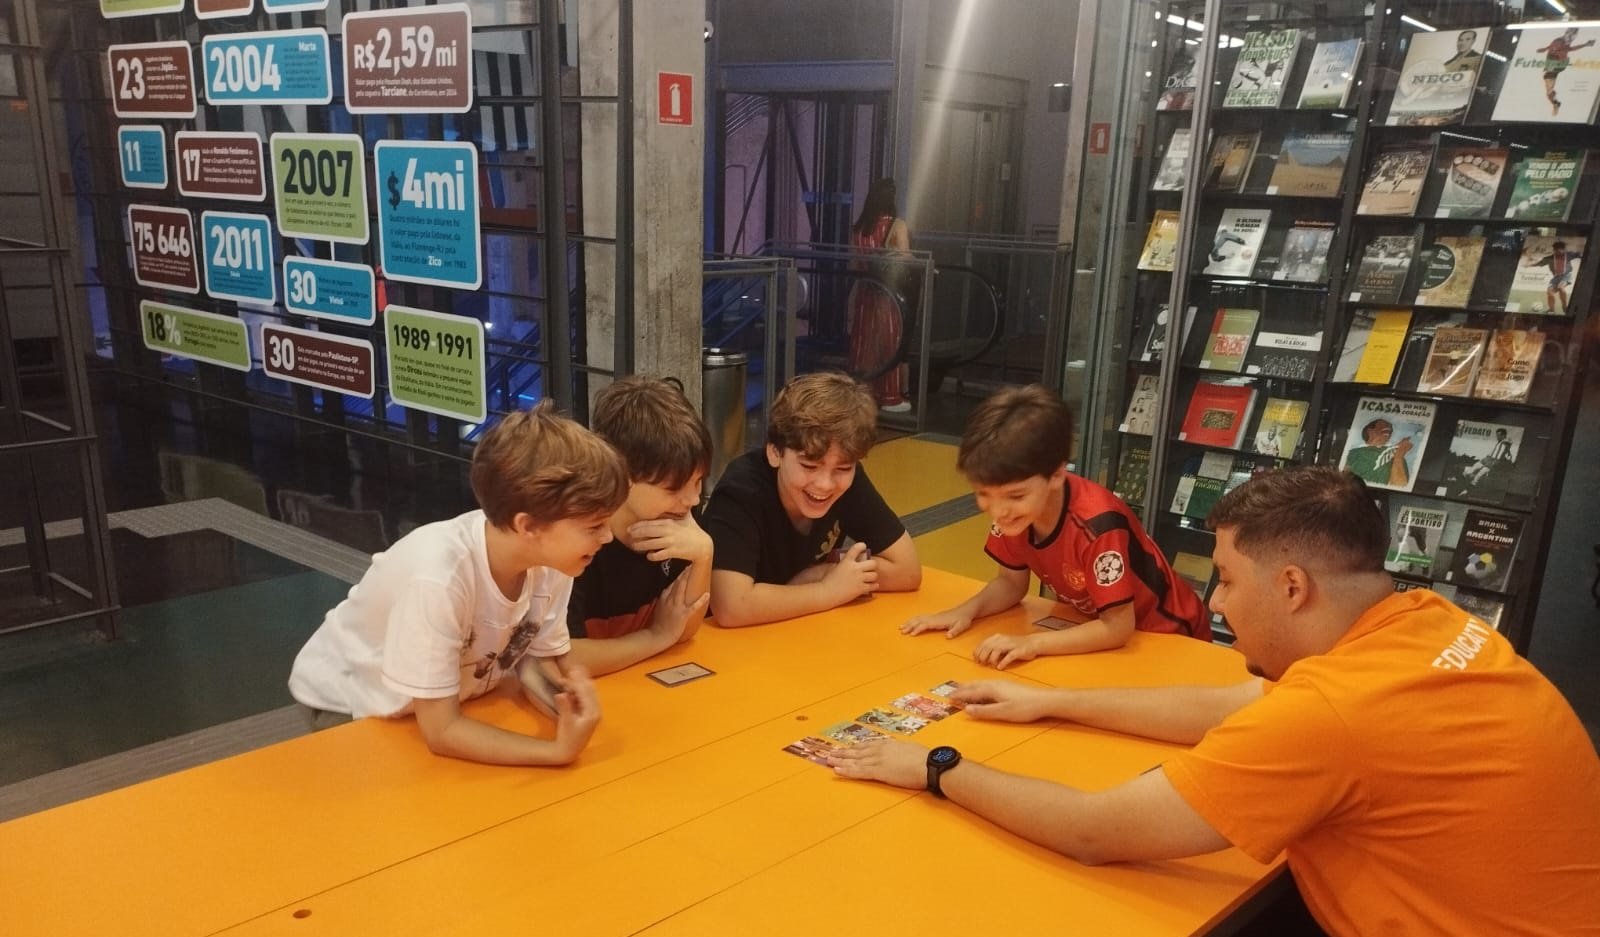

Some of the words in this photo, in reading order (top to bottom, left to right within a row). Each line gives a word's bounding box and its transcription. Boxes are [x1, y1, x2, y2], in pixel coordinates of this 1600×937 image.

[117, 57, 146, 99] 23
[210, 44, 281, 93] 2004
[1412, 72, 1464, 85] NECO
[125, 141, 142, 172] 11
[183, 149, 200, 182] 17
[281, 148, 353, 198] 2007
[134, 222, 155, 253] 75
[157, 224, 191, 258] 646
[211, 225, 264, 271] 2011
[290, 269, 317, 305] 30
[147, 311, 182, 346] 18%
[269, 335, 295, 371] 30
[1361, 401, 1401, 414] ICASA
[1466, 530, 1514, 544] ARGENTINA
[1478, 520, 1508, 530] BRASIL
